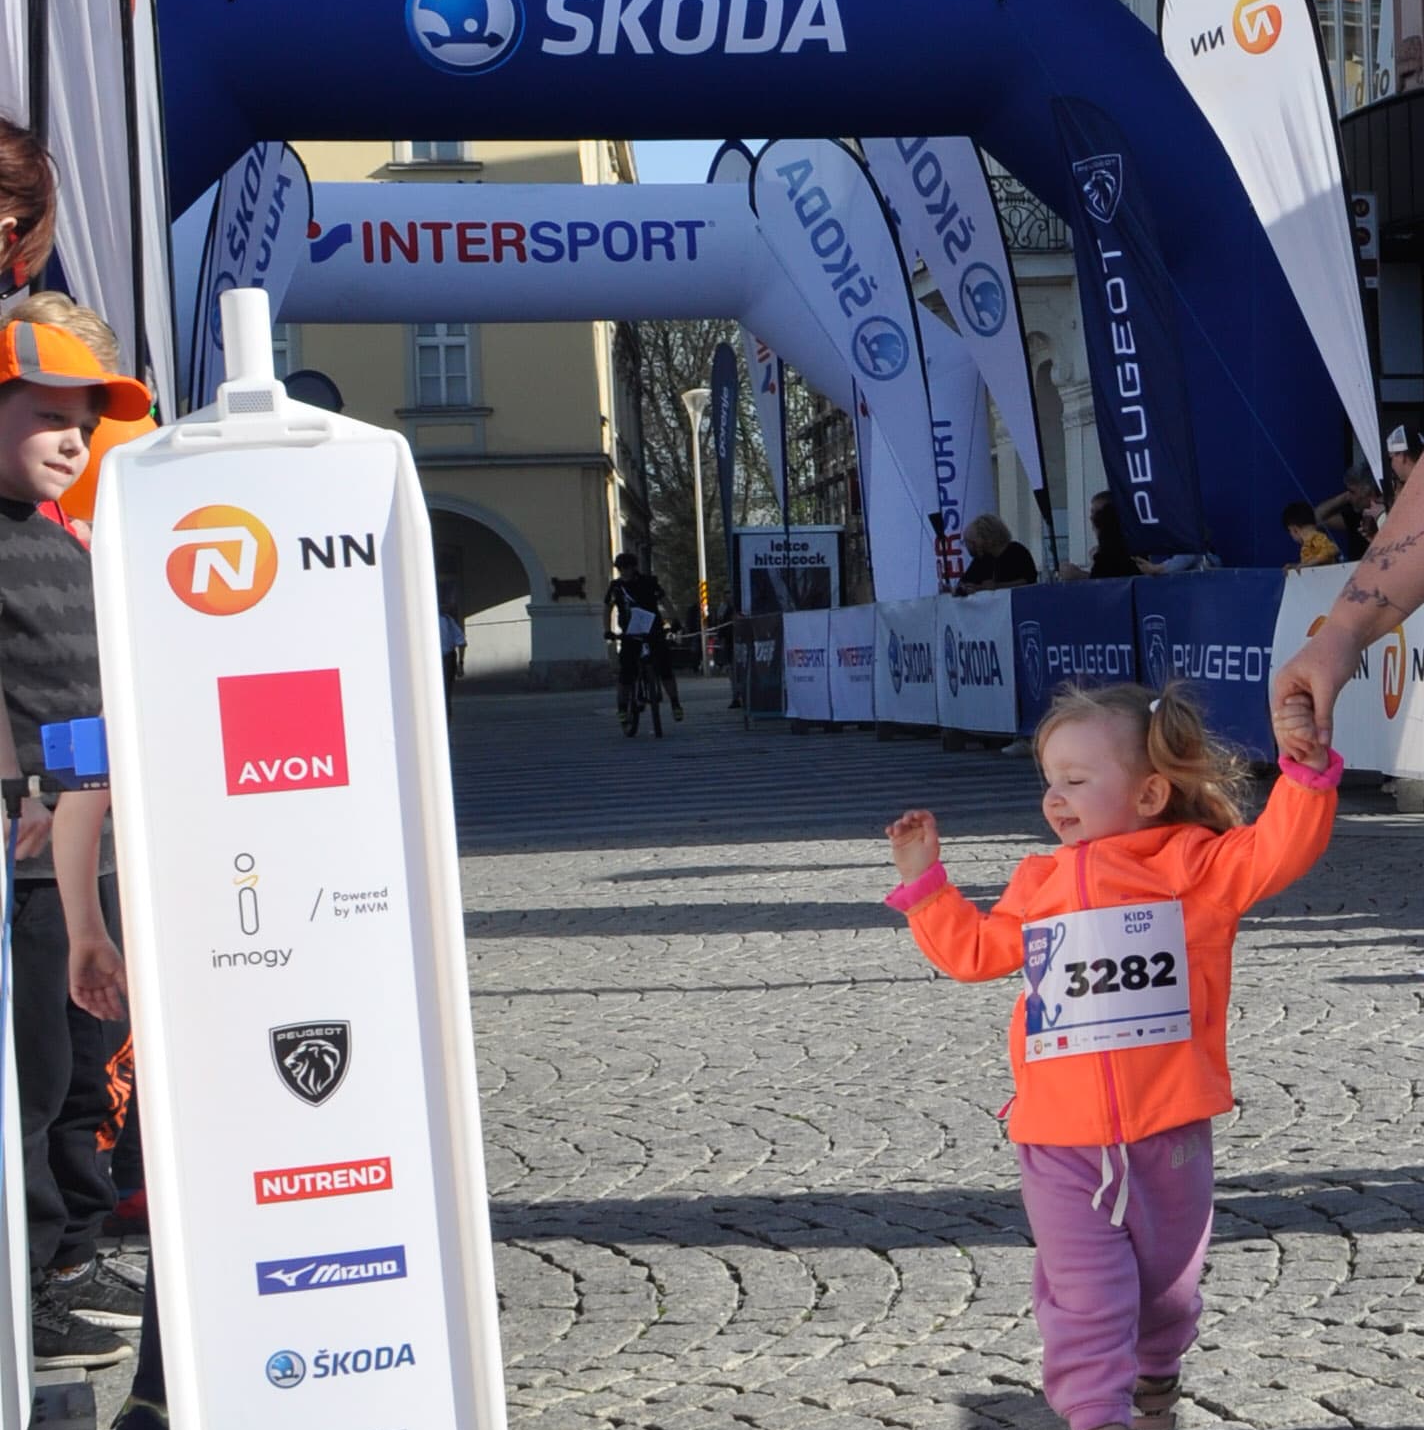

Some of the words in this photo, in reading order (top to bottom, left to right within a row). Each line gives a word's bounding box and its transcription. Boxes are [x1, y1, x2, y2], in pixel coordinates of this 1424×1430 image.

[363, 218, 701, 264] INTERSPORT
[1097, 238, 1160, 524] PEUGEOT
[298, 532, 377, 571] NN
[754, 552, 827, 566] hitchcock
[958, 631, 1004, 686] ŠKODA
[1047, 644, 1132, 675] PEUGEOT
[238, 754, 334, 785] AVON
[333, 886, 388, 902] Powered
[334, 907, 350, 919] by
[355, 902, 388, 915] MVM
[1124, 910, 1153, 923] KIDS
[1125, 923, 1151, 934] CUP
[1029, 937, 1048, 951] KIDS
[211, 947, 293, 969] innogy
[1029, 953, 1047, 968] CUP
[1064, 951, 1178, 998] 3282
[276, 1026, 344, 1041] PEUGEOT
[261, 1164, 386, 1198] NUTREND
[313, 1342, 416, 1380] ŠKODA
